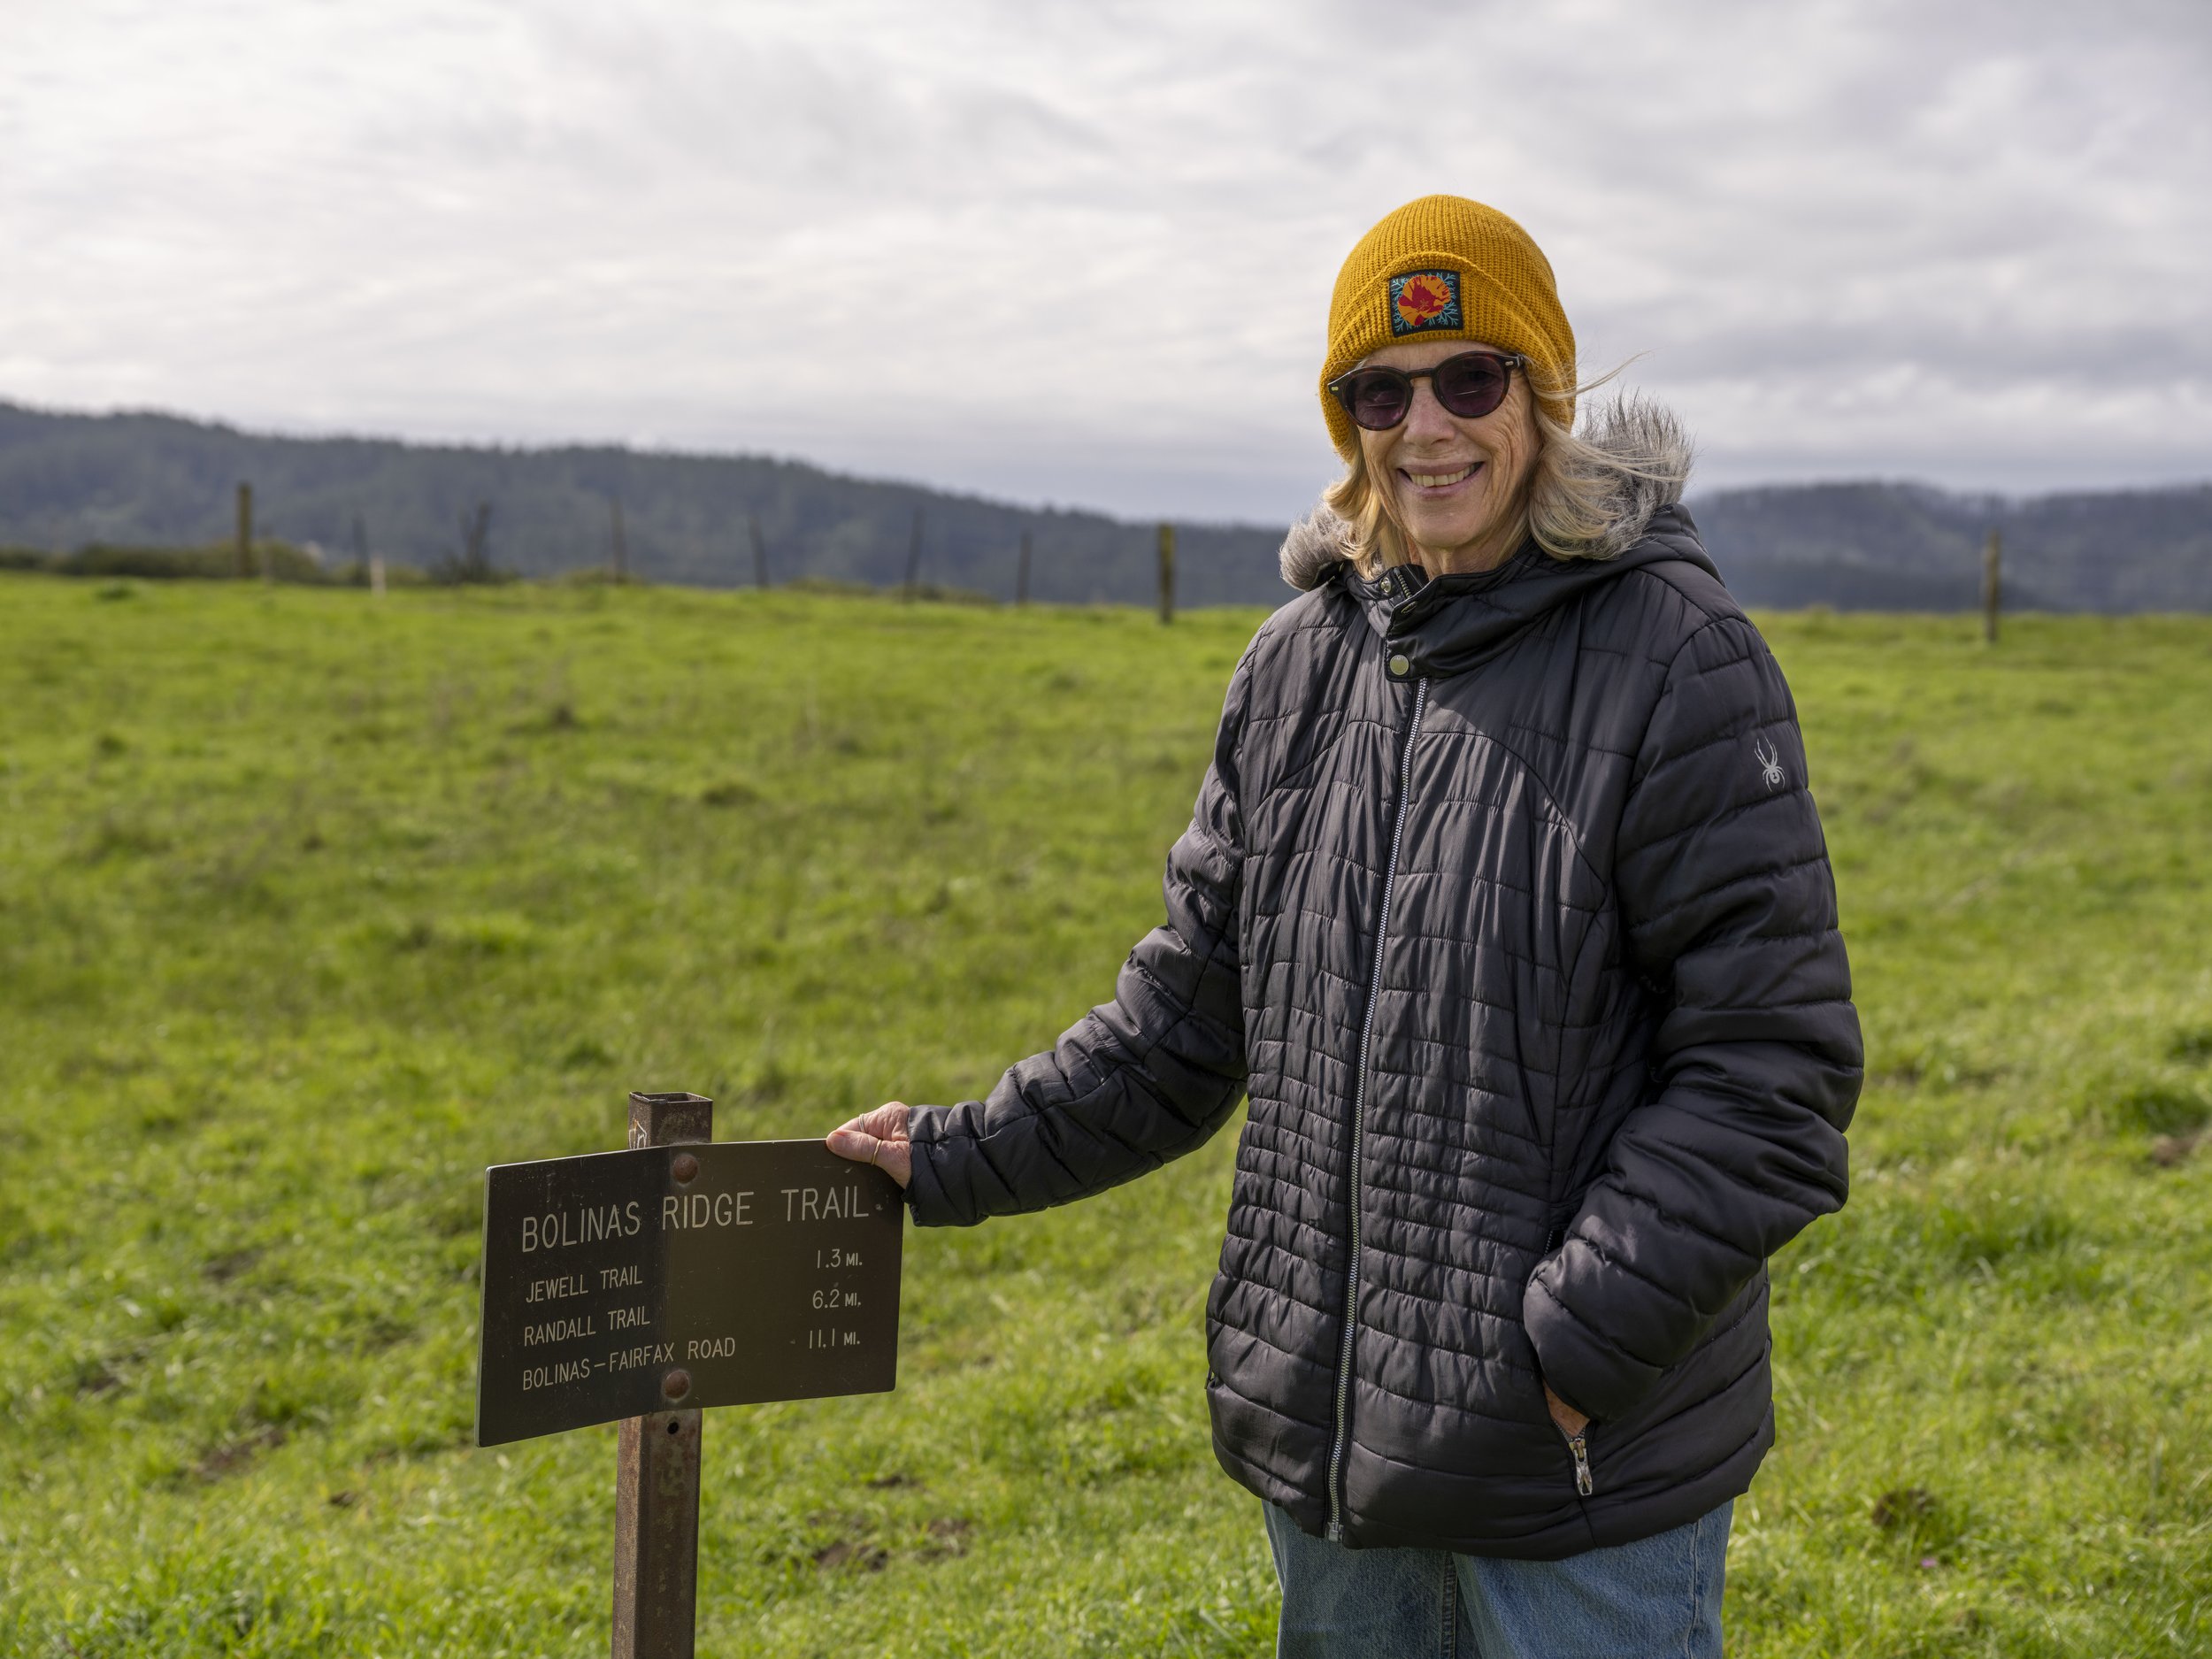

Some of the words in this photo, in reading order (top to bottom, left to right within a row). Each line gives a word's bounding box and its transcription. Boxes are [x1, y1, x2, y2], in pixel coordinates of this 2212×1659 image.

[522, 1201, 641, 1253] BOLINAS
[662, 1191, 755, 1231] RIDGE
[780, 1185, 870, 1223] TRAIL
[526, 1274, 589, 1303] JEWELL
[600, 1264, 643, 1290] TRAIL
[817, 1248, 841, 1269] 1.3
[845, 1252, 863, 1267] MI.
[524, 1315, 596, 1347] RANDALL
[607, 1305, 651, 1331] TRAIL
[812, 1288, 841, 1310] 6.2
[844, 1292, 862, 1307] MI.
[687, 1337, 736, 1360] ROAD
[809, 1327, 835, 1349] 11.1
[843, 1331, 861, 1346] MI.
